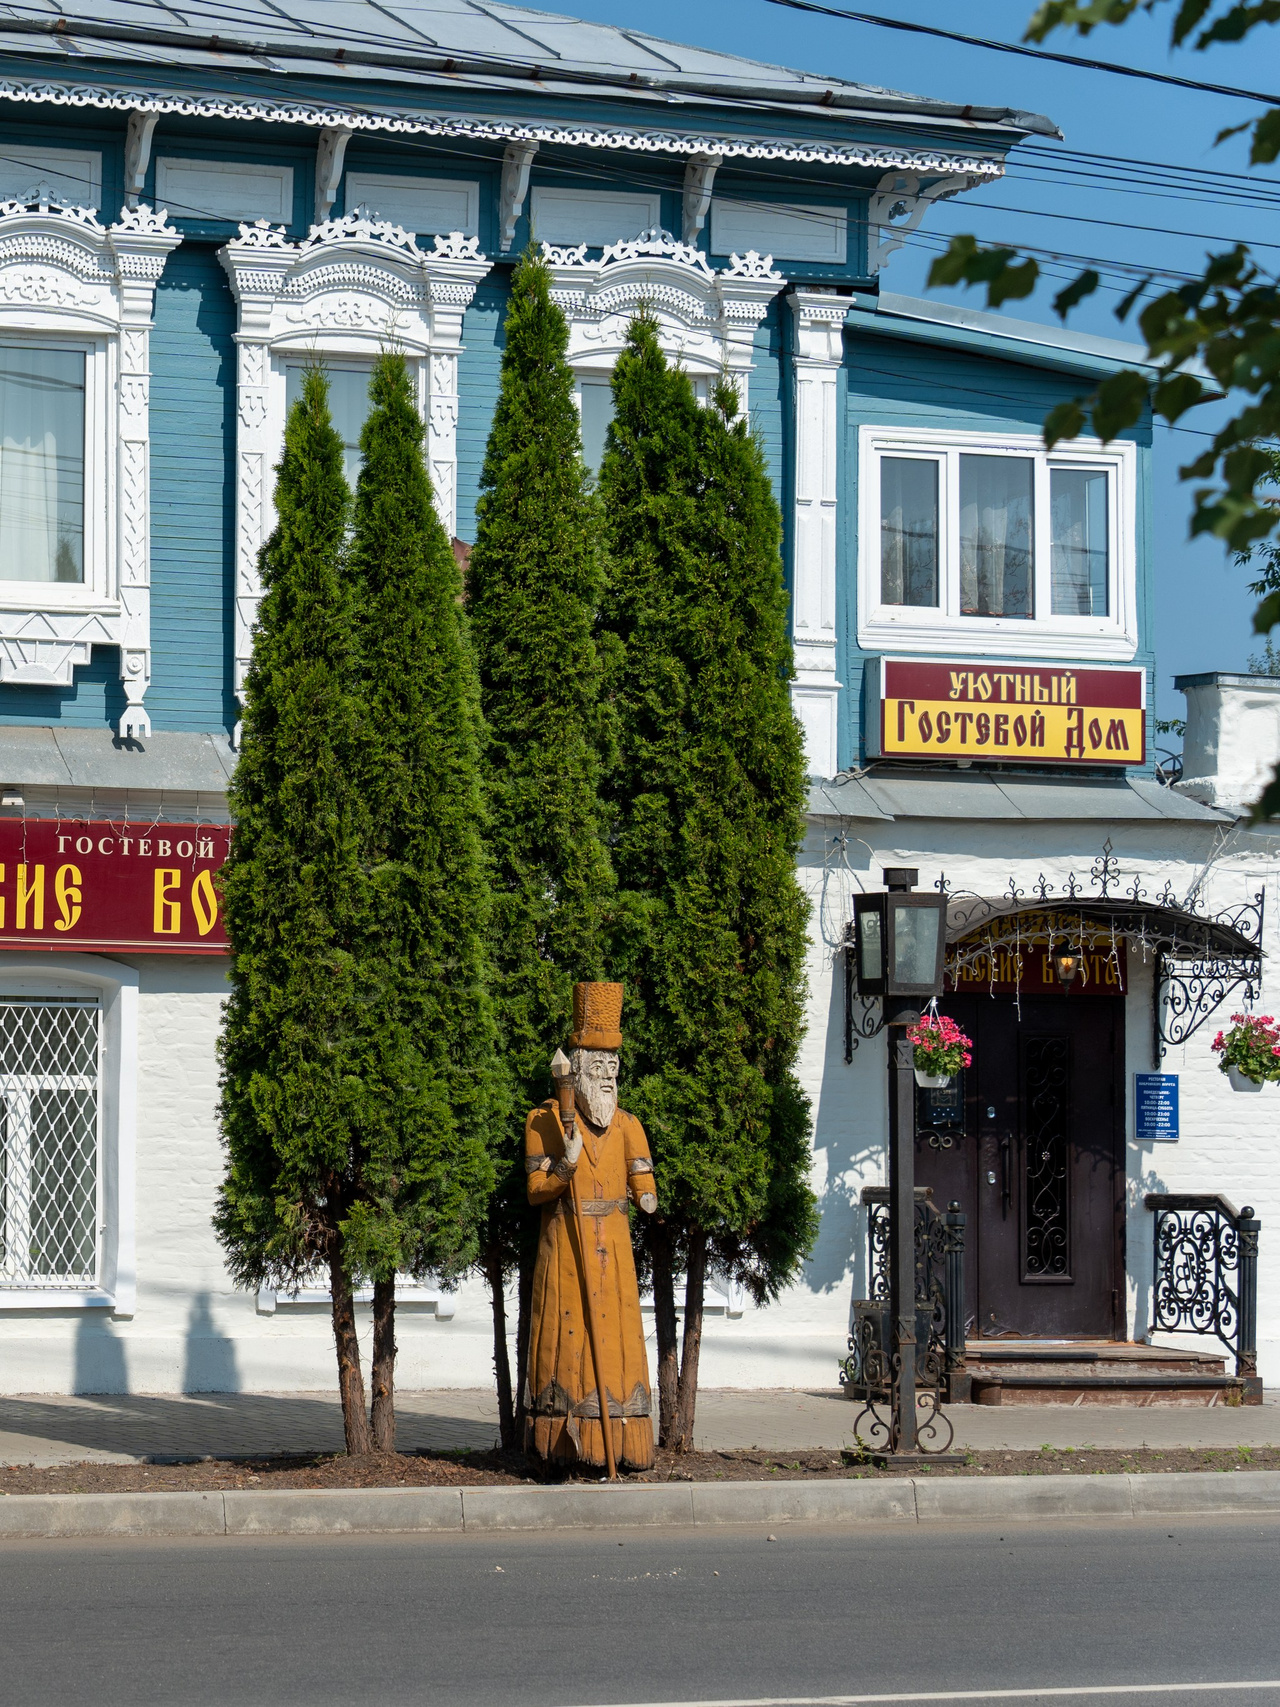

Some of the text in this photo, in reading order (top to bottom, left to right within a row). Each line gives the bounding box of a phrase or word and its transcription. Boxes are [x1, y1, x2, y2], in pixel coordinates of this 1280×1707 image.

[949, 671, 1077, 704] УЮТНЫЙ
[897, 700, 1129, 758] Гостевой Дом
[58, 834, 216, 860] ГОСТЕВОЙ
